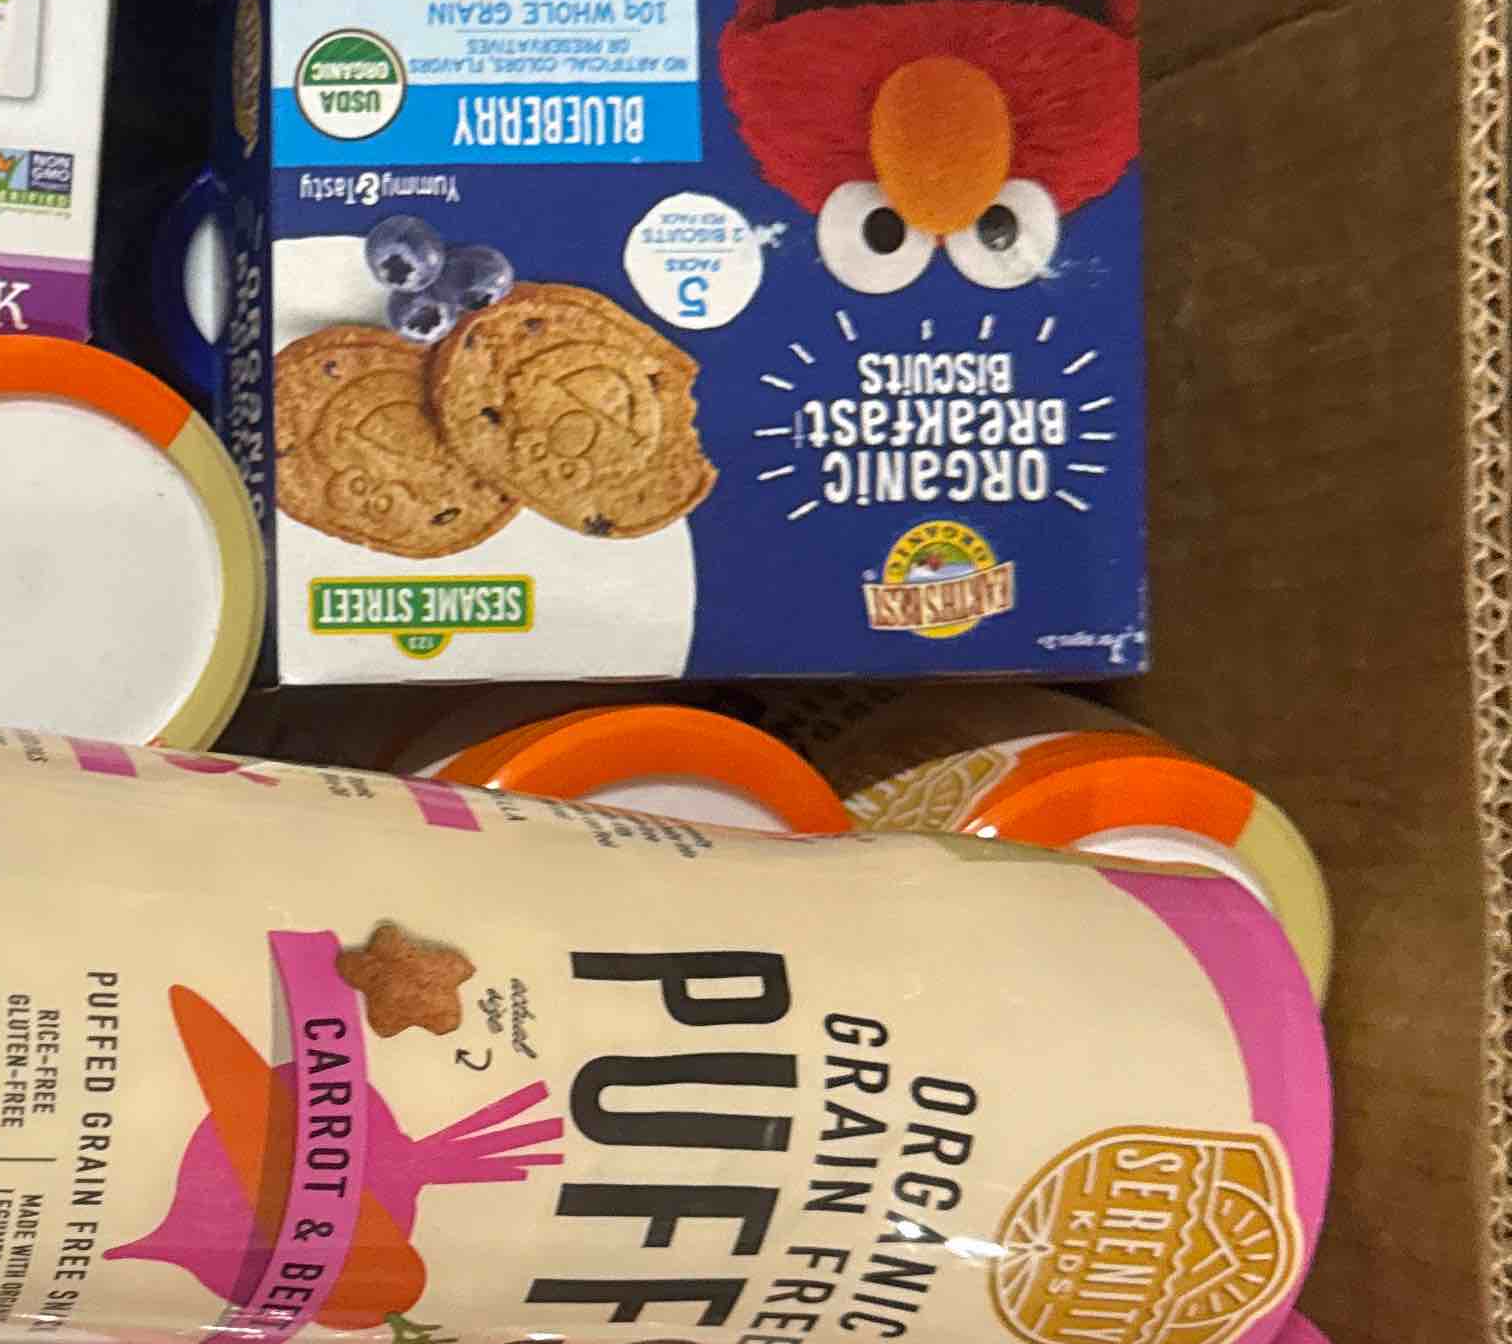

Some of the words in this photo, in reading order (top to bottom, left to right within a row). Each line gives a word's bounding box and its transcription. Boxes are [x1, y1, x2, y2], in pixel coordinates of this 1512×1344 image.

[426, 2, 513, 26] GRAIN
[521, 2, 617, 25] WHOLE
[310, 61, 389, 81] ORGANIC
[319, 89, 382, 113] USDA
[452, 93, 646, 147] BLUEBERRY
[298, 173, 358, 205] Tasty
[380, 172, 461, 203] Yummy
[677, 276, 709, 318] 5
[318, 586, 414, 625] STREET
[421, 584, 523, 623] SESAME
[408, 636, 435, 651] 123
[82, 970, 120, 1094] PUFFED
[508, 977, 538, 1059] actual
[0, 993, 31, 1130] GLUTEN-FREE
[31, 1008, 61, 1115] RICE-FREE
[302, 1016, 353, 1199] CARROT
[803, 1012, 890, 1216] GRAIN
[71, 1111, 112, 1207] GRAIN
[12, 1193, 45, 1240] MADE
[838, 1073, 980, 1341] ORGANIC
[54, 1220, 98, 1282] FREE
[292, 1218, 335, 1244] &
[1047, 1210, 1096, 1297] KIDS
[1058, 1148, 1183, 1344] SERENITY
[3, 1243, 32, 1279] WITH
